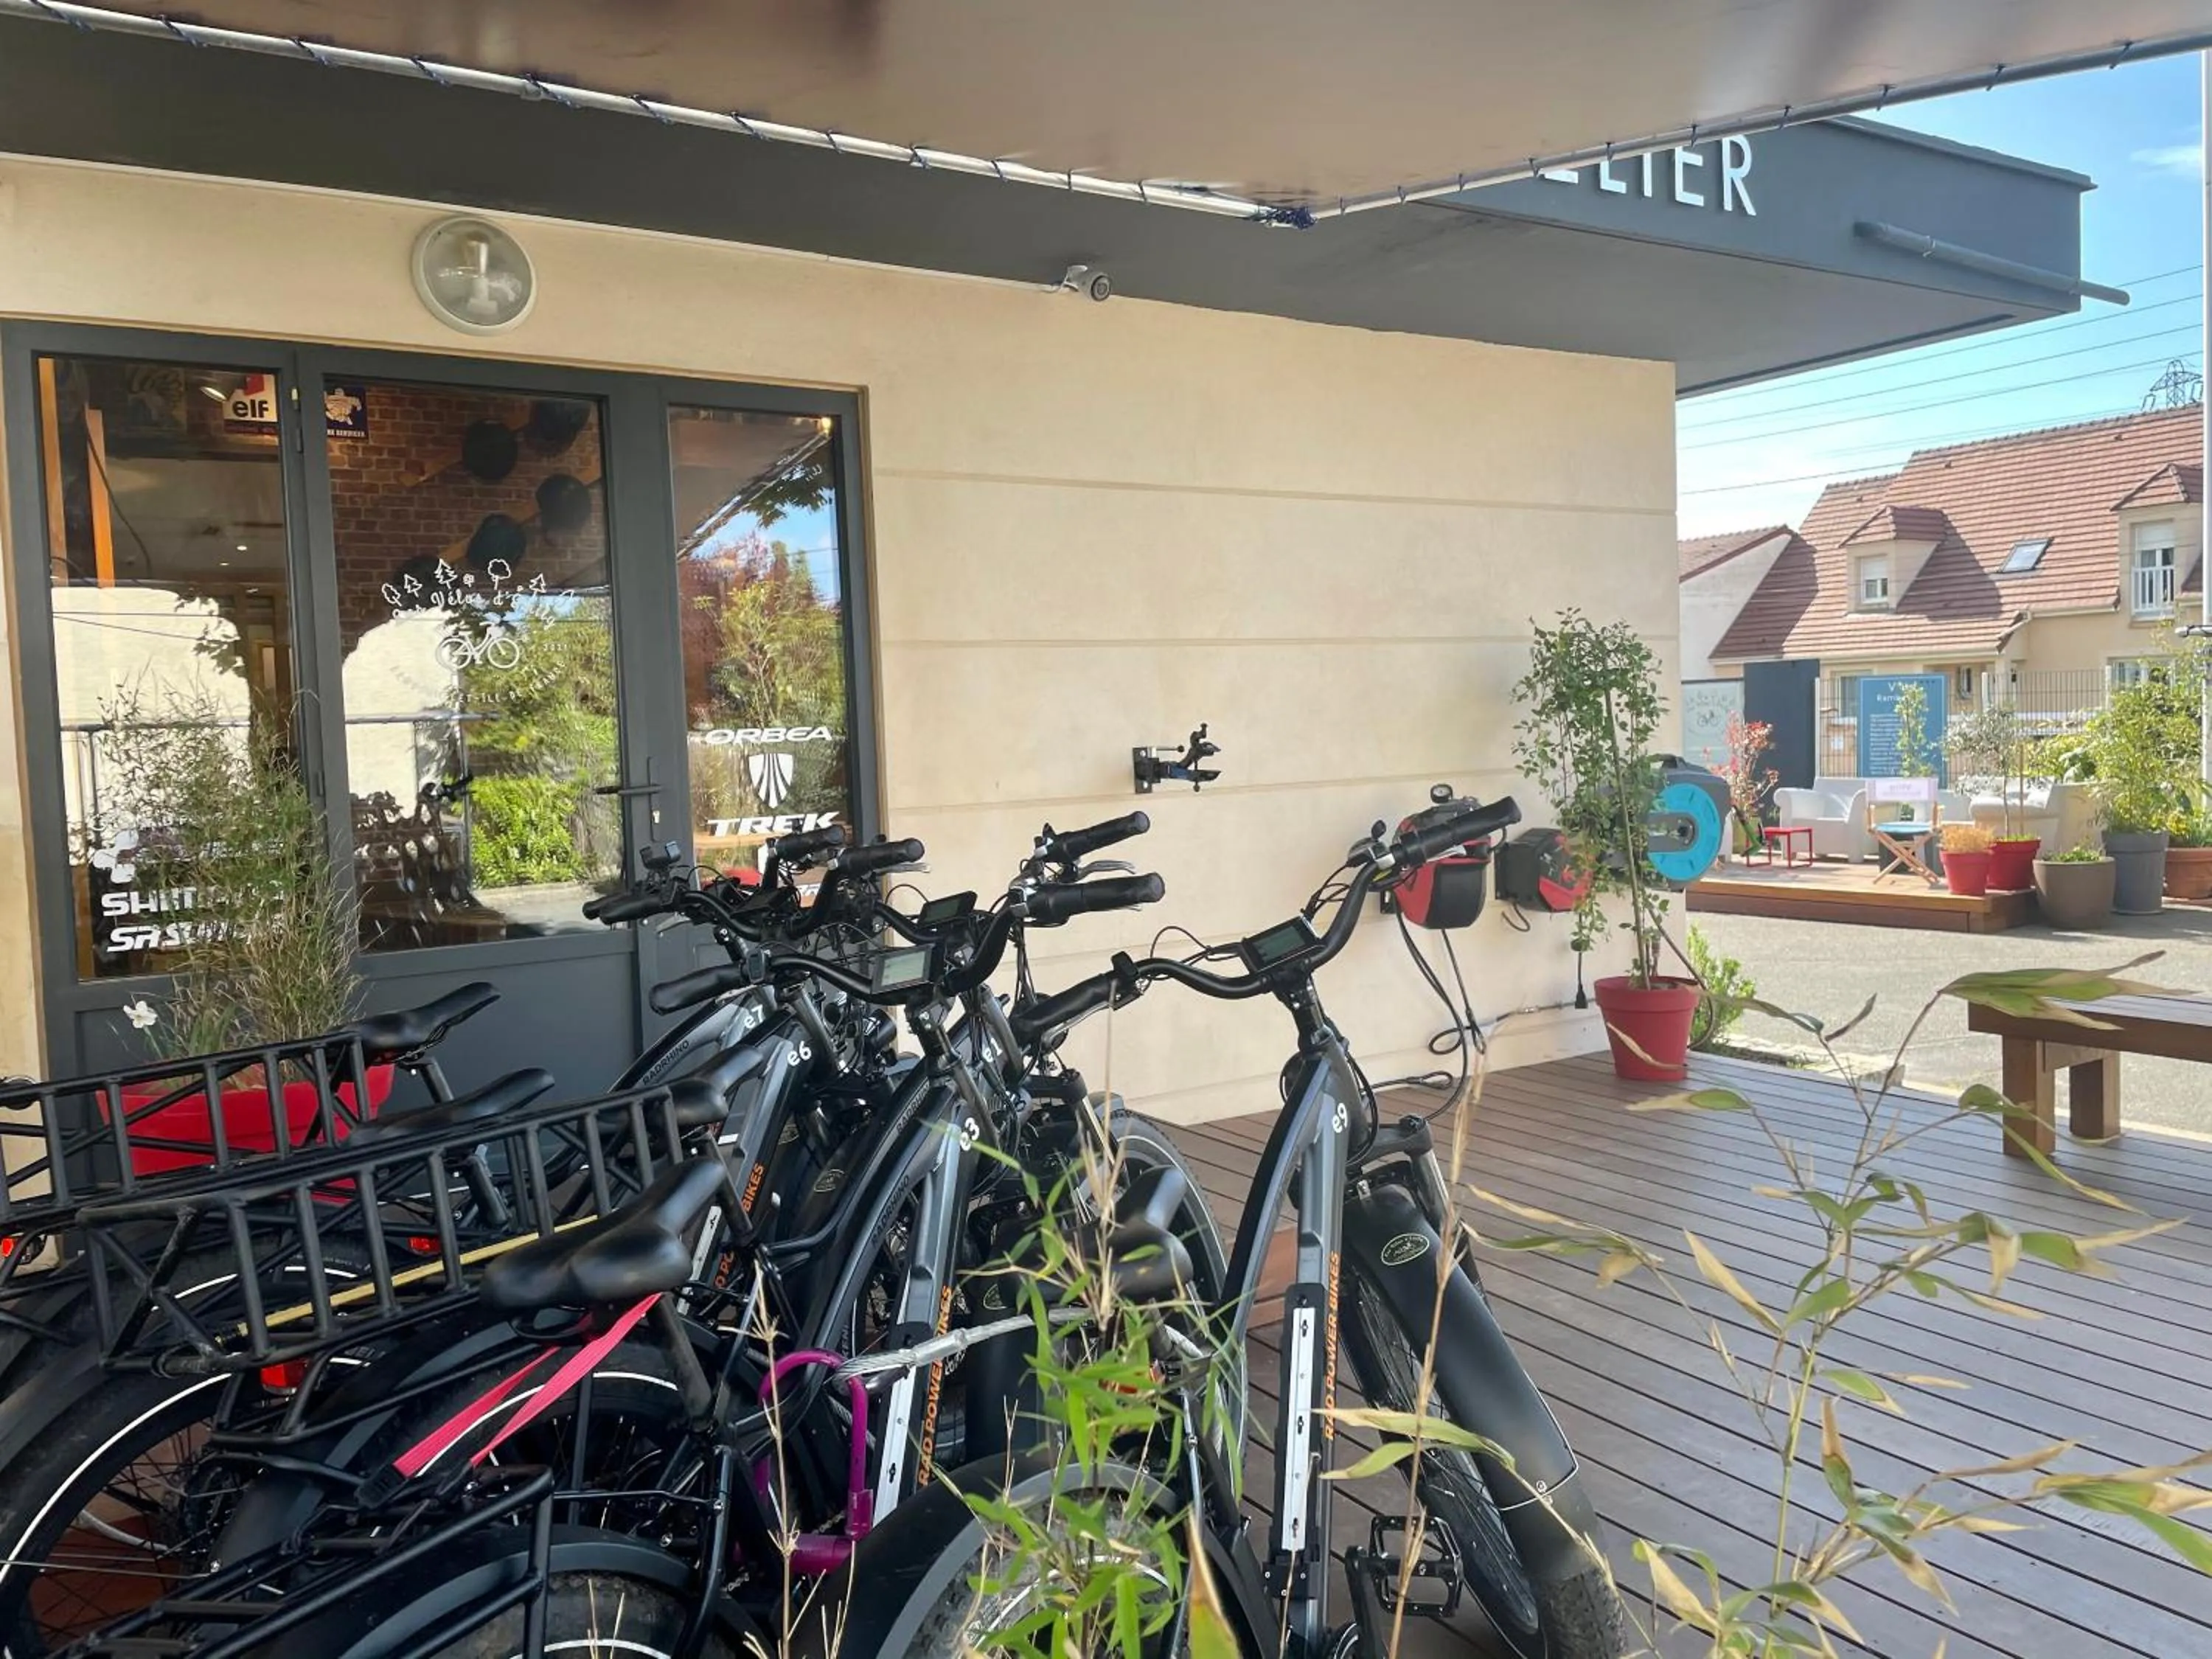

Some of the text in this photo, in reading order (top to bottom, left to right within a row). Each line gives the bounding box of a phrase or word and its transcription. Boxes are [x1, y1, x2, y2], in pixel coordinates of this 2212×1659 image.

[1540, 135, 1756, 216] LIER
[232, 399, 269, 418] elf
[705, 726, 832, 745] ORBEA
[707, 812, 839, 837] TREK
[743, 1004, 765, 1029] e7
[642, 1040, 690, 1086] RADRHINO
[786, 1040, 812, 1066] e6
[1331, 1102, 1349, 1134] e9
[959, 1117, 979, 1152] e3
[1329, 1251, 1340, 1310] BIKES
[1326, 1315, 1338, 1392] POWER
